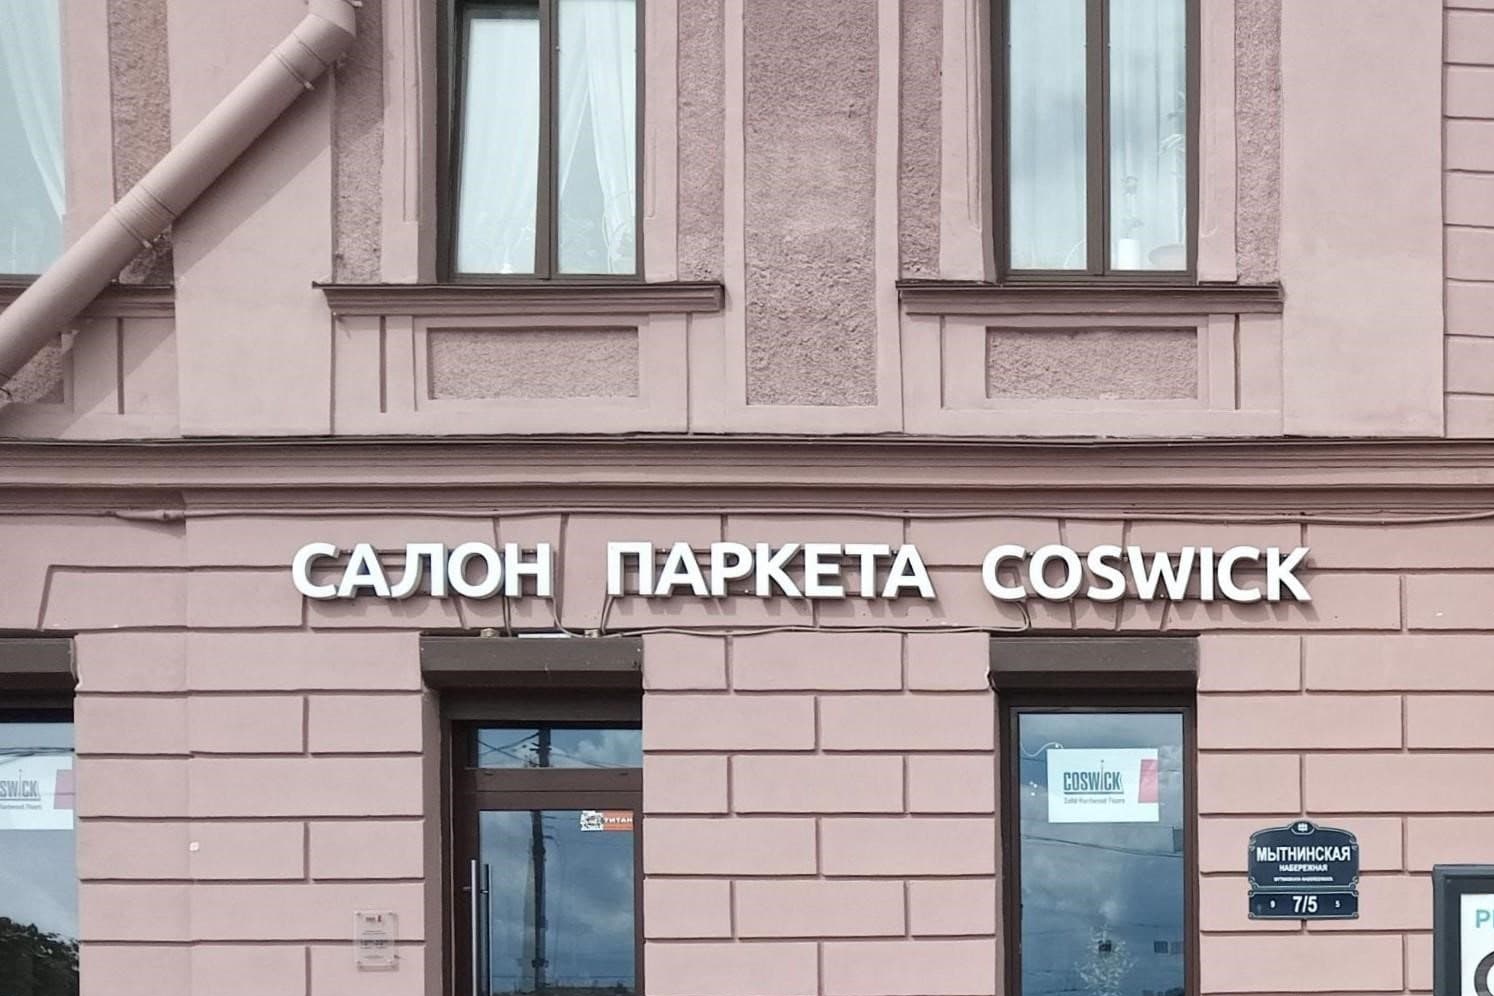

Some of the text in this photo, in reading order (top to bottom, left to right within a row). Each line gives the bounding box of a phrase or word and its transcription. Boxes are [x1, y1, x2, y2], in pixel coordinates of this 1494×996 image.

[291, 541, 1314, 603] САЛОН ПАРКЕТА COSWICK
[1063, 759, 1124, 792] COSWICK
[1256, 845, 1351, 862] МЫТНИНСКАЯ
[1279, 864, 1328, 872] НАБЕРЕЖНАЯ
[1292, 895, 1318, 913] 7/5
